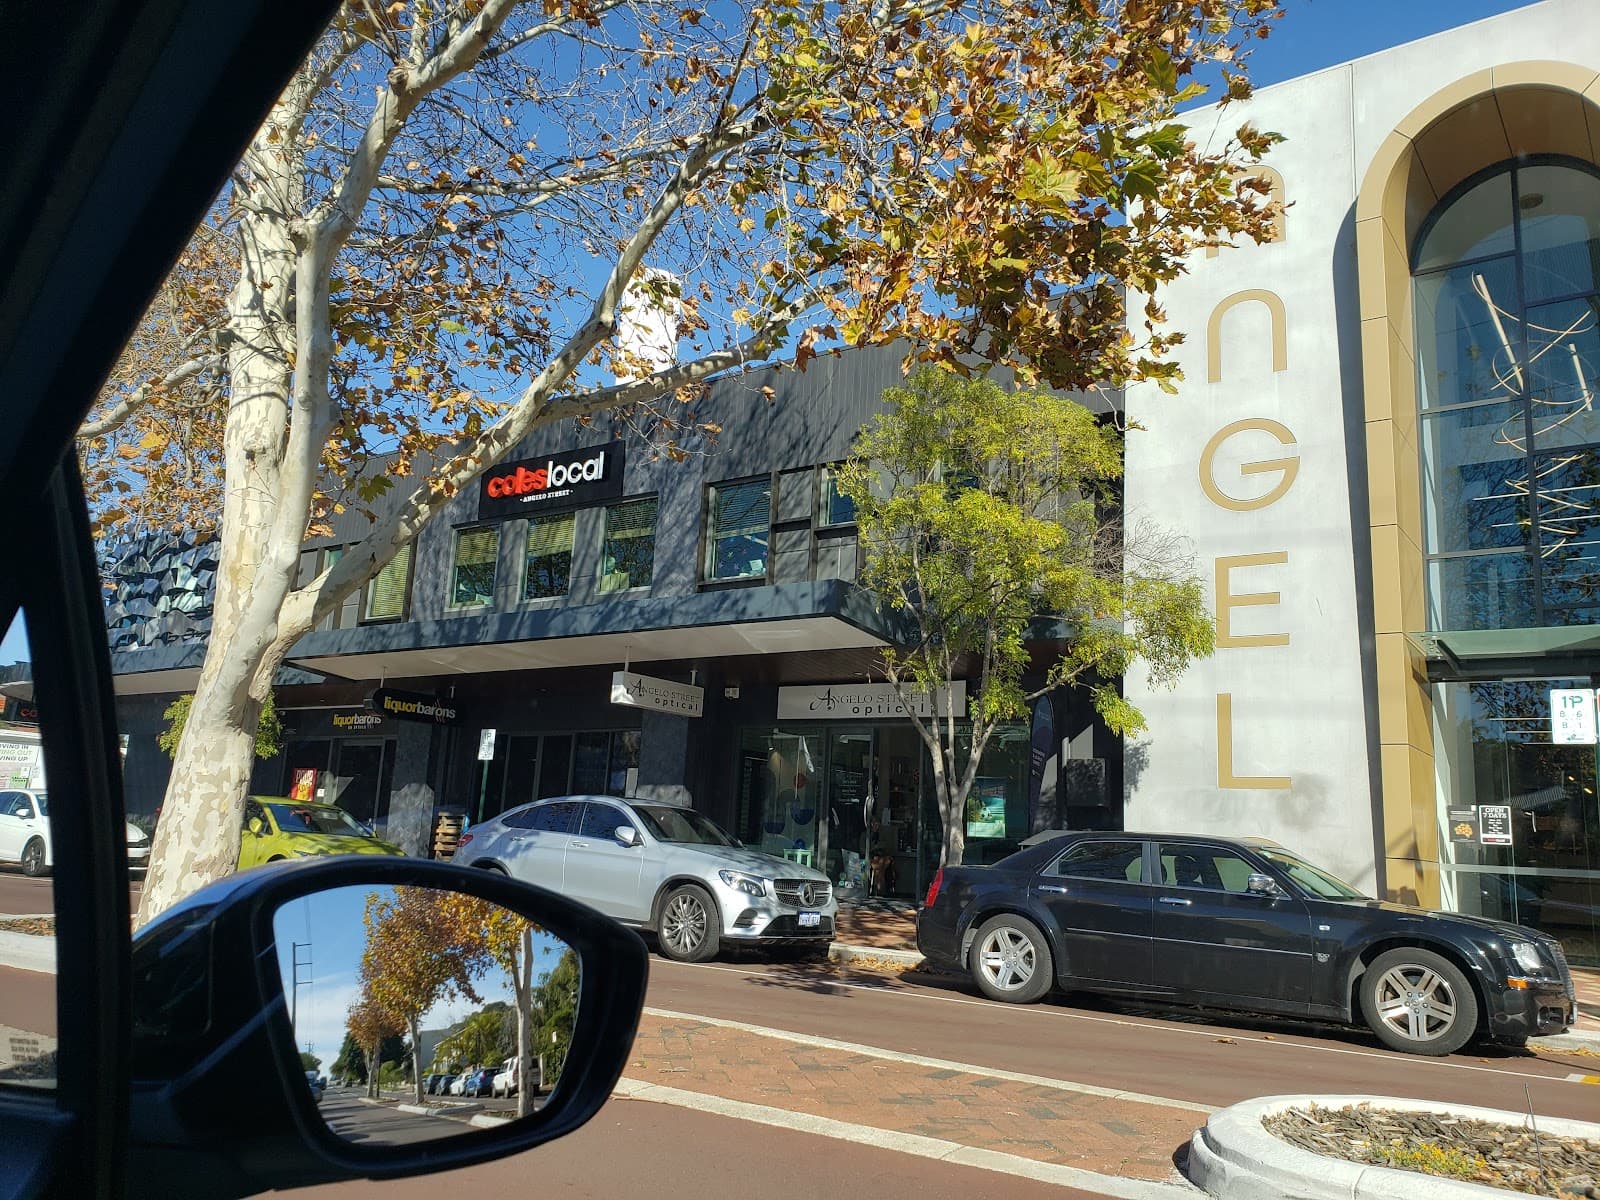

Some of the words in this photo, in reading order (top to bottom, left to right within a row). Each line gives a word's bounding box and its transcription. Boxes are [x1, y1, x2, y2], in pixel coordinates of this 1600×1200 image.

[522, 493, 547, 503] ANGELO
[547, 489, 570, 499] STREET
[626, 678, 670, 697] ANGELO
[654, 697, 698, 711] optical
[809, 687, 873, 712] ANGELO
[1561, 695, 1584, 709] 1P
